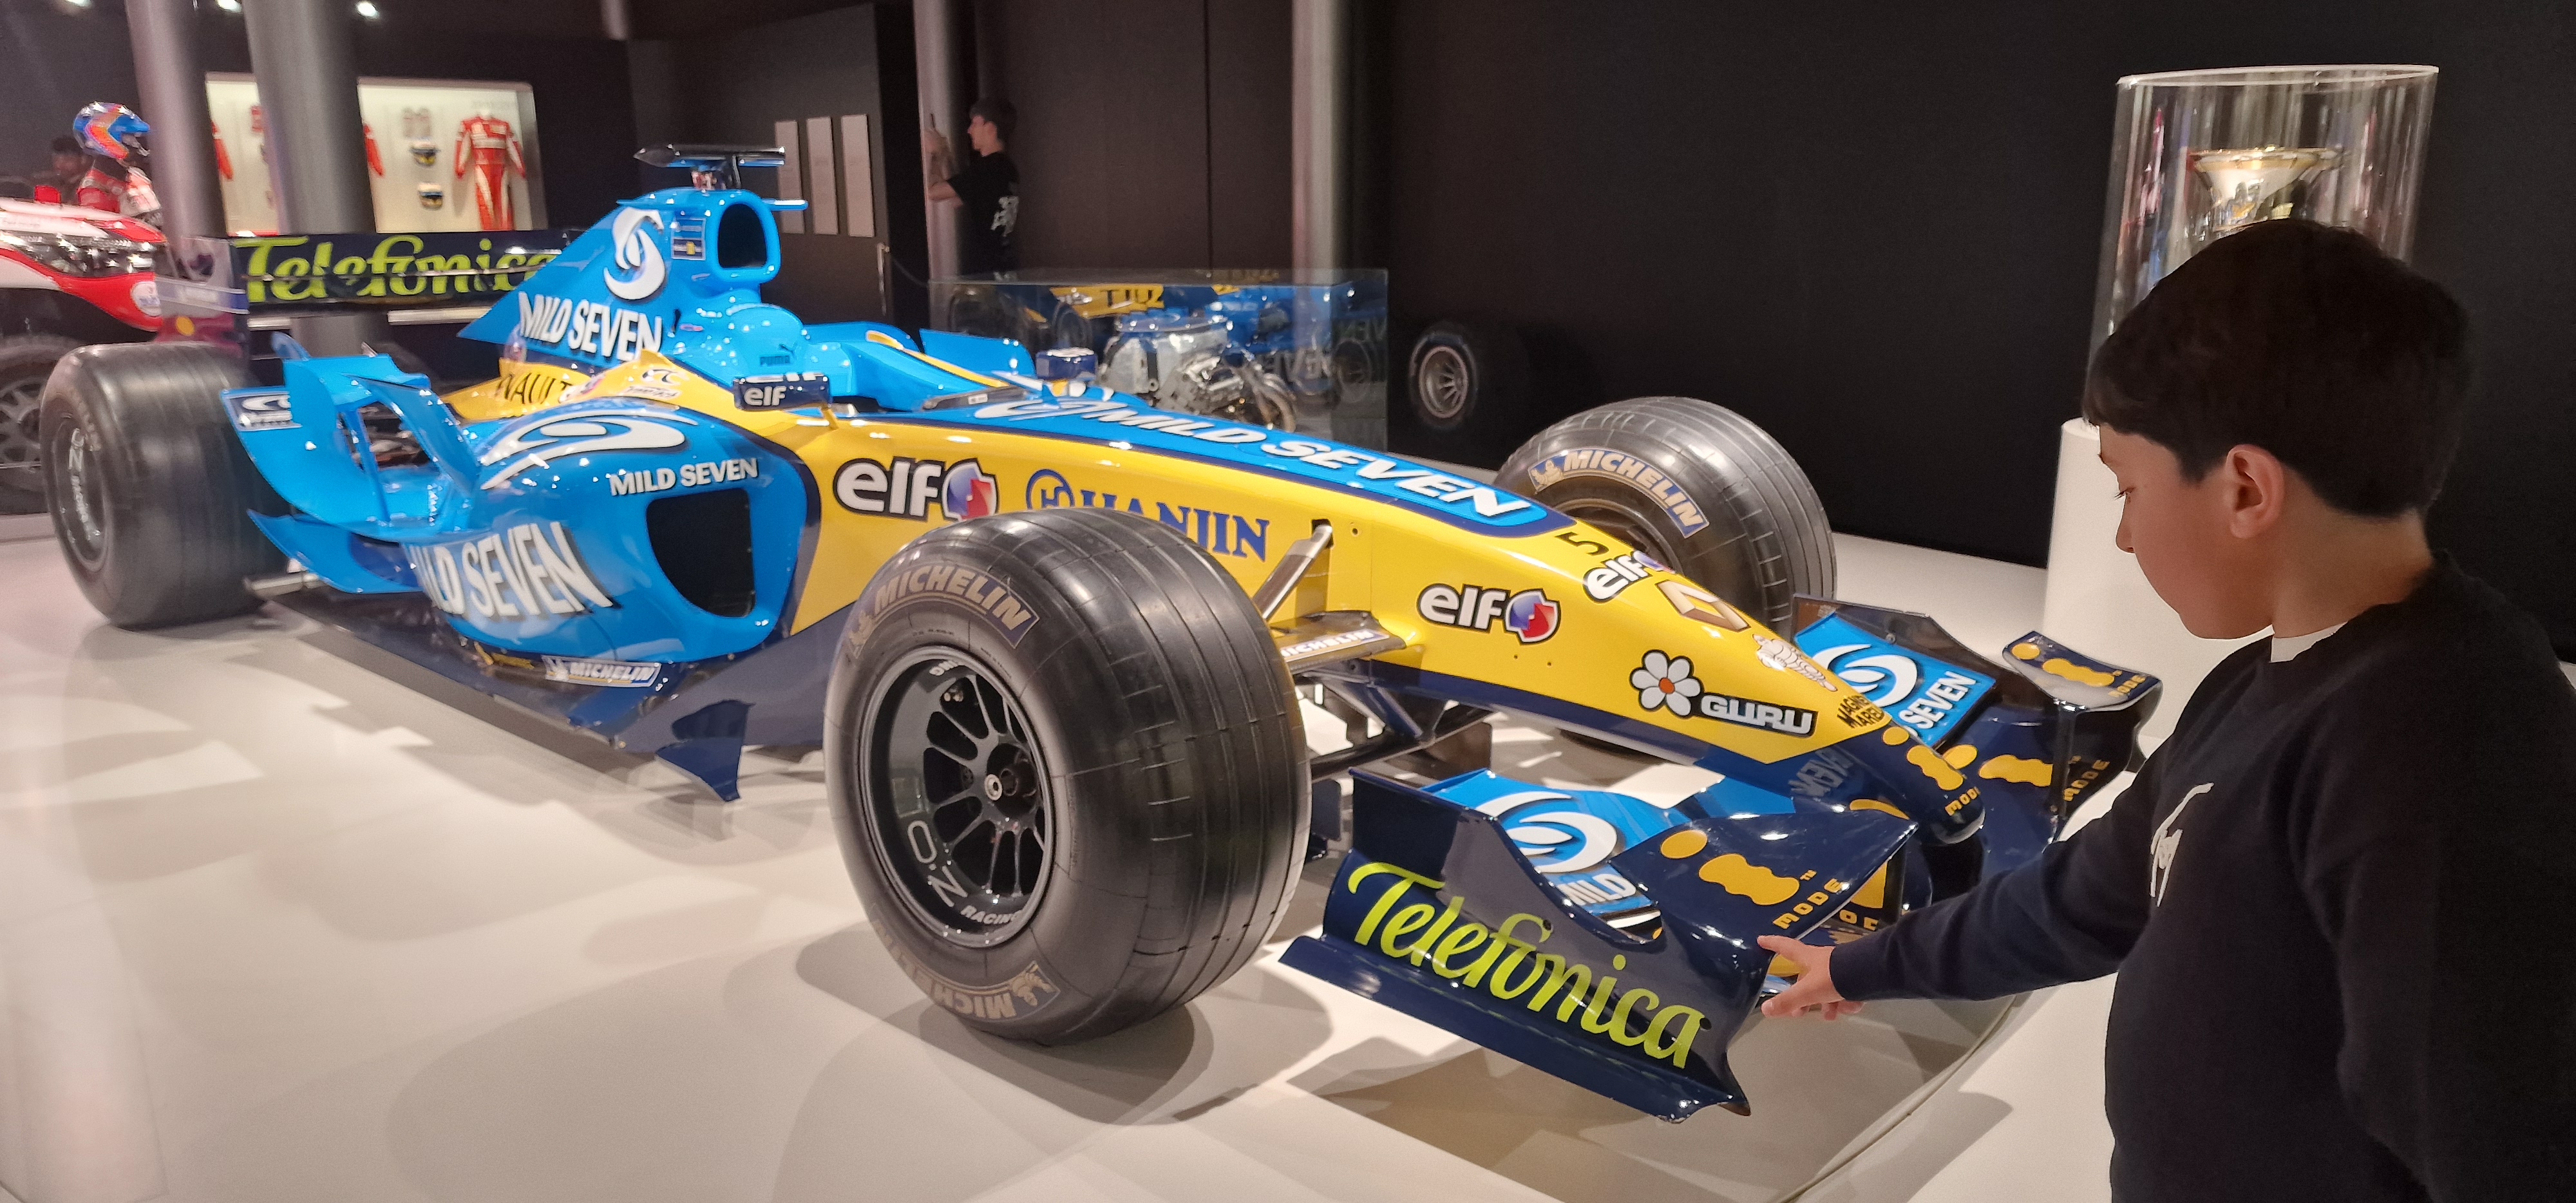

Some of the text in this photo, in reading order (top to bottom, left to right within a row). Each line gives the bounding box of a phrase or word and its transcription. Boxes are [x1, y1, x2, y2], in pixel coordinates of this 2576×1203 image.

[518, 291, 662, 361] MILD SEVEN
[744, 386, 787, 406] elf
[609, 458, 758, 496] MILD SEVEN
[1081, 408, 1530, 518] MILD SEVEN
[837, 461, 942, 517] elf
[1564, 450, 1703, 527] MICHELIN
[1555, 531, 1609, 556] 5
[461, 522, 614, 618] SEVEN
[1584, 556, 1649, 601] elf
[874, 565, 1032, 630] MICHELIN
[1419, 586, 1508, 630] elf
[570, 662, 654, 681] MICHELIN
[1701, 695, 1812, 734] GURU
[1899, 671, 1976, 729] SEVEN
[2063, 759, 2110, 802] MODE
[1772, 878, 1847, 930] MODE
